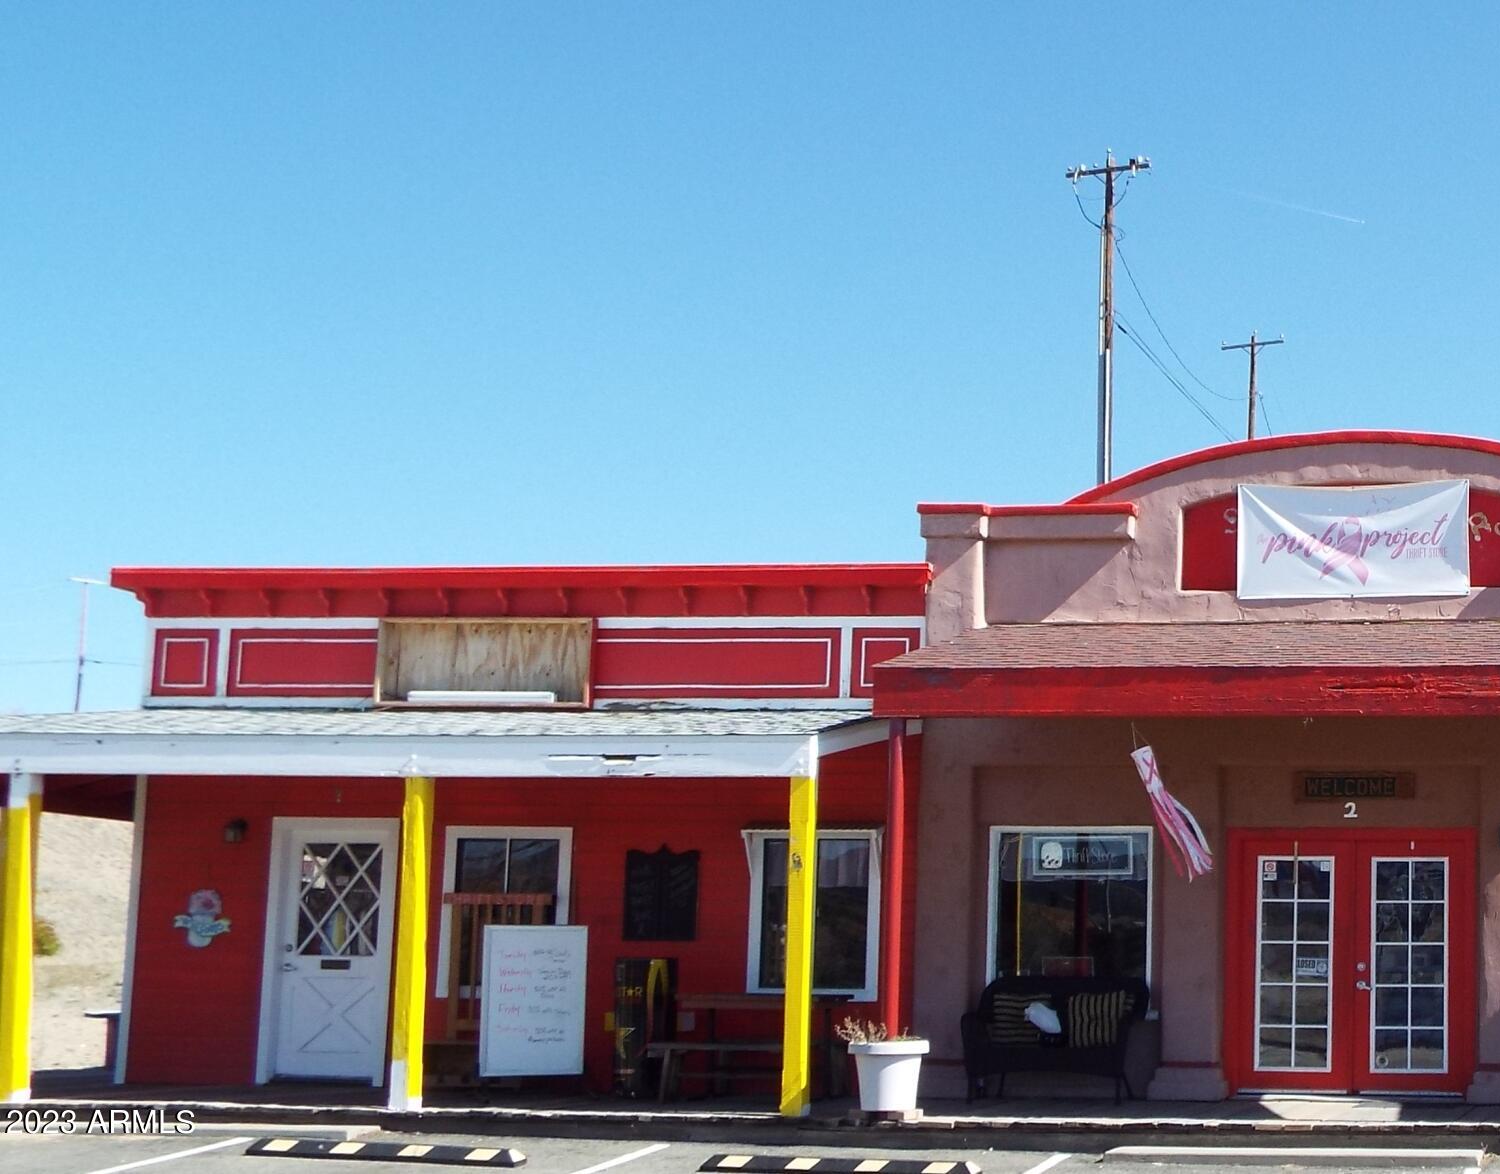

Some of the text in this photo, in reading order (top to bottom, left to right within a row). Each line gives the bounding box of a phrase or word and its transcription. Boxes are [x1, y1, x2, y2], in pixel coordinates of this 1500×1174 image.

[1358, 512, 1449, 560] project
[1305, 777, 1394, 797] WELCOME
[1343, 801, 1358, 818] 2
[1297, 960, 1316, 969] LOSED
